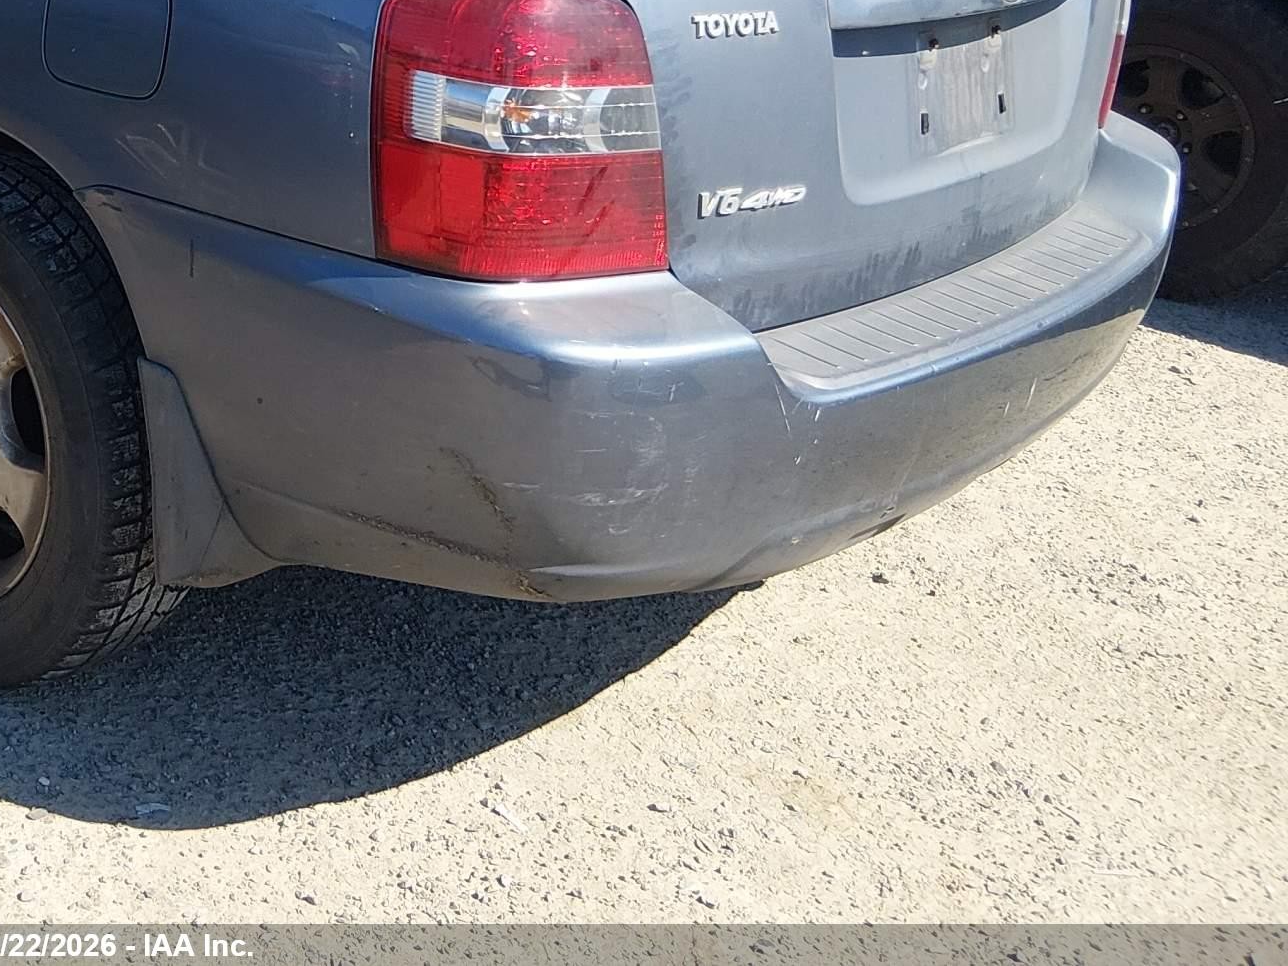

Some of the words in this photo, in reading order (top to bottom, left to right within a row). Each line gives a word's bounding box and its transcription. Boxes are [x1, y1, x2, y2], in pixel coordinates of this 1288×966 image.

[691, 11, 780, 40] TOYOTA
[697, 187, 743, 220] V6
[740, 185, 807, 212] 4WD
